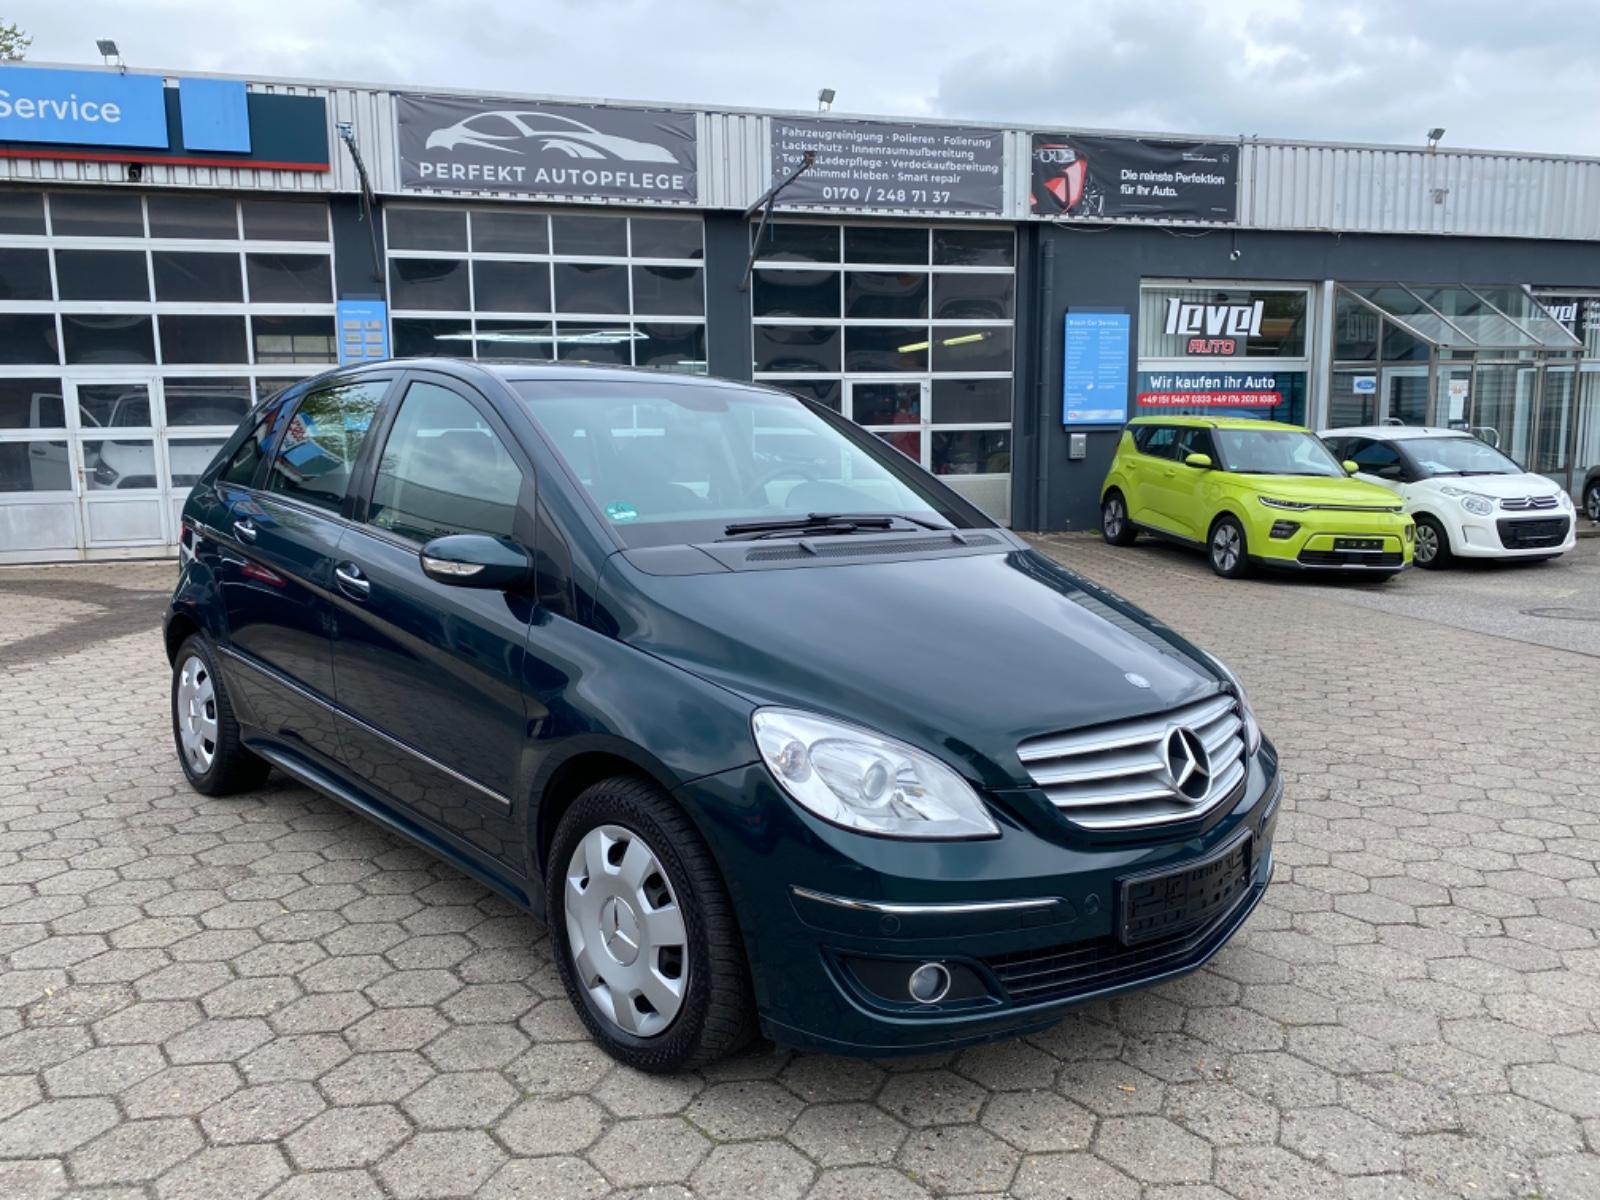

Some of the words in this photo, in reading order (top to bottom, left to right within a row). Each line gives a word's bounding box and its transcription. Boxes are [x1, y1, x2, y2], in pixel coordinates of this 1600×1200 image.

[0, 90, 121, 123] Service
[782, 127, 883, 144] Fahrzeugreinigung
[893, 133, 935, 144] Polieren
[943, 136, 991, 149] Folierung
[782, 140, 843, 152] Lackschutz
[851, 144, 974, 160] Innenraumaufbereitung
[782, 166, 850, 179] Dhhimmel
[853, 169, 889, 180] kleben
[897, 172, 928, 182] Smart
[931, 173, 961, 184] repair
[892, 159, 999, 174] Verdeckaufbereitung
[420, 162, 526, 182] PERFEKT
[535, 168, 684, 190] AUTOPFLEGE
[1121, 169, 1138, 180] Die
[1139, 170, 1173, 182] reinste
[1175, 172, 1225, 185] Perfektion
[823, 186, 860, 200] 0170
[865, 185, 872, 202] /
[877, 188, 906, 202] 248
[912, 189, 927, 202] 71
[933, 191, 950, 203] 37
[1120, 184, 1135, 195] für
[1137, 184, 1150, 195] Ihr
[1152, 185, 1178, 196] Auto.
[1166, 298, 1264, 337] level
[1188, 339, 1235, 354] AUTO
[1150, 376, 1172, 388] Wir
[1176, 376, 1220, 388] kaufen
[1224, 376, 1241, 388] ihr
[1244, 377, 1275, 389] Auto
